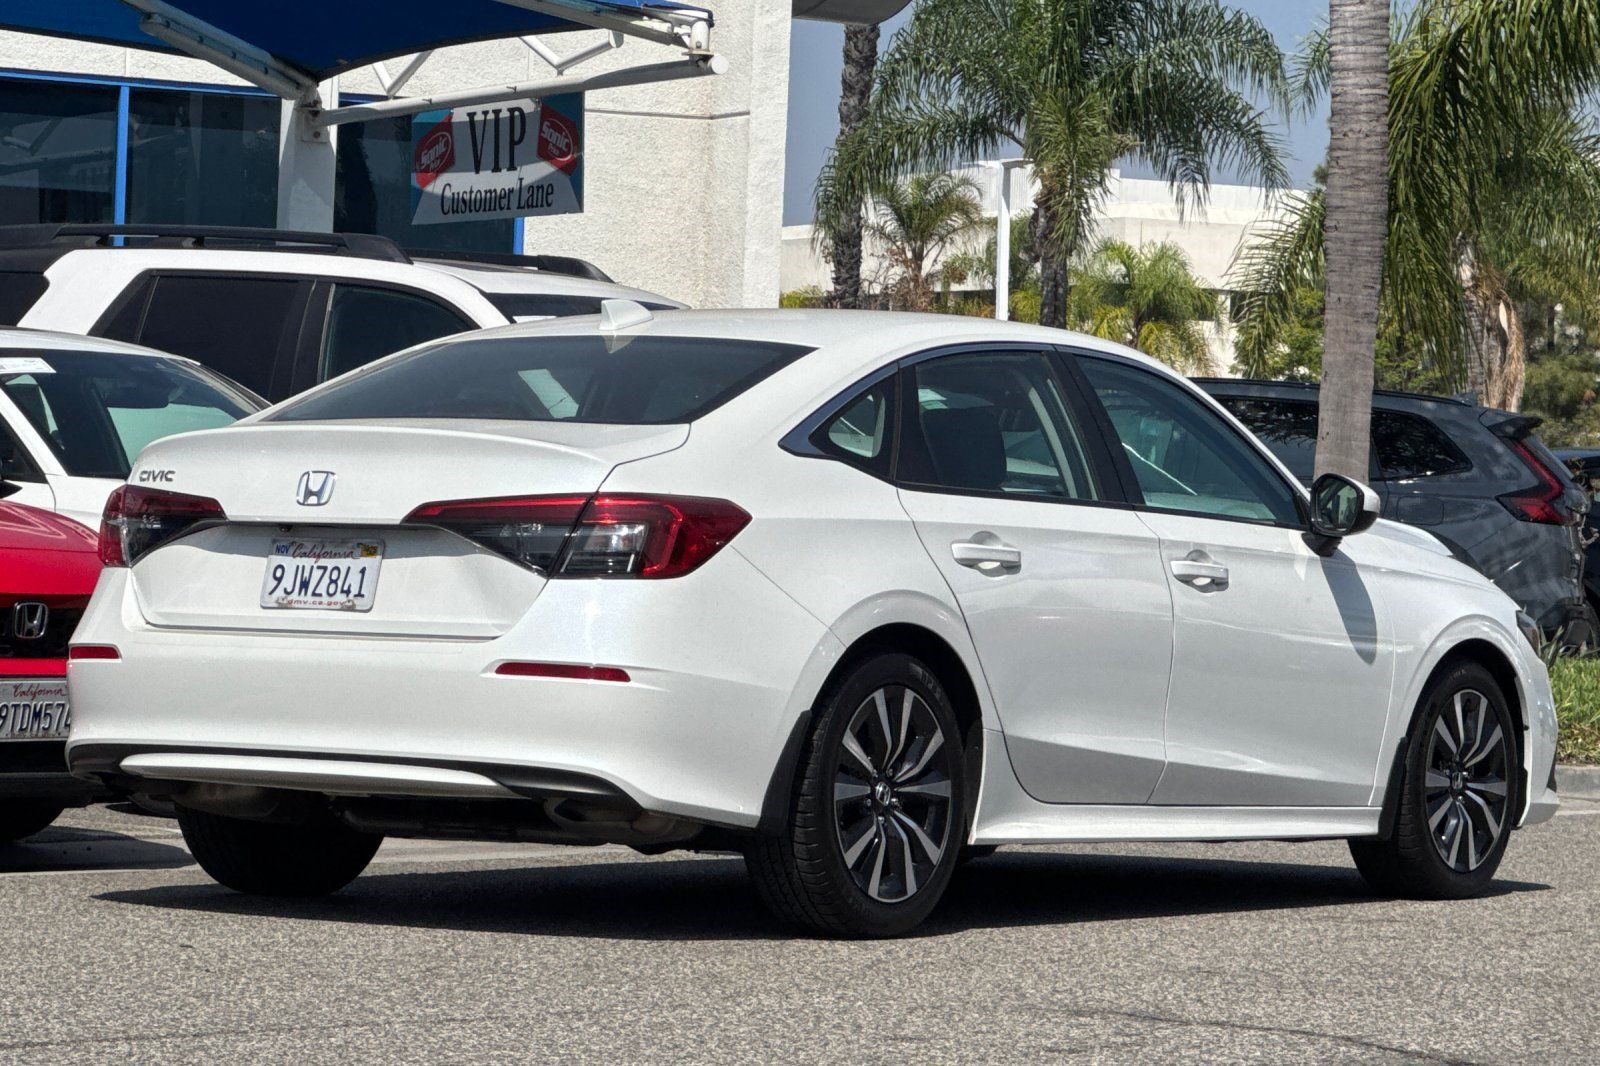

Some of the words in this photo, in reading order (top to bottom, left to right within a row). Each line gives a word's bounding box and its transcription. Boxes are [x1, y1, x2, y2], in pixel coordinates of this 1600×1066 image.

[467, 106, 526, 174] VIP
[541, 121, 569, 151] Sonic
[420, 136, 447, 169] Sonic
[441, 183, 514, 215] Customer
[516, 178, 554, 210] Lane
[139, 470, 176, 482] CIVIC
[275, 544, 290, 554] NOV
[290, 541, 360, 563] California
[268, 564, 367, 598] 9JWZ841
[287, 599, 346, 607] dmv.ca.gov
[13, 683, 66, 700] California
